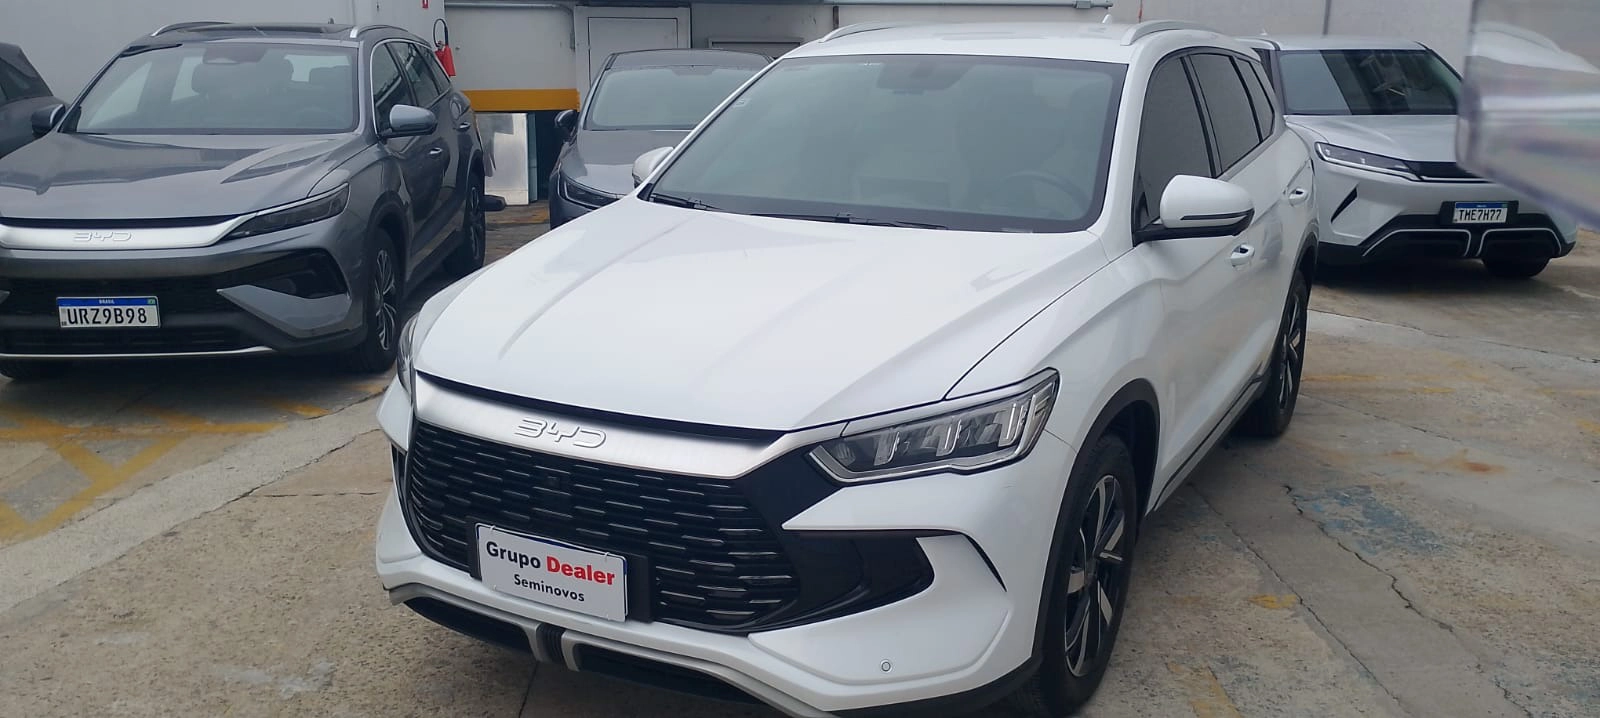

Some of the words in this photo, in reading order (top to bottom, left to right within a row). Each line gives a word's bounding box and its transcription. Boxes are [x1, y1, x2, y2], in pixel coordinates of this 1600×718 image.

[67, 308, 147, 325] URZ9B98
[514, 417, 606, 448] BYD
[486, 541, 541, 569] Grupo
[546, 556, 615, 585] Dealer
[514, 574, 585, 602] Seminovos
